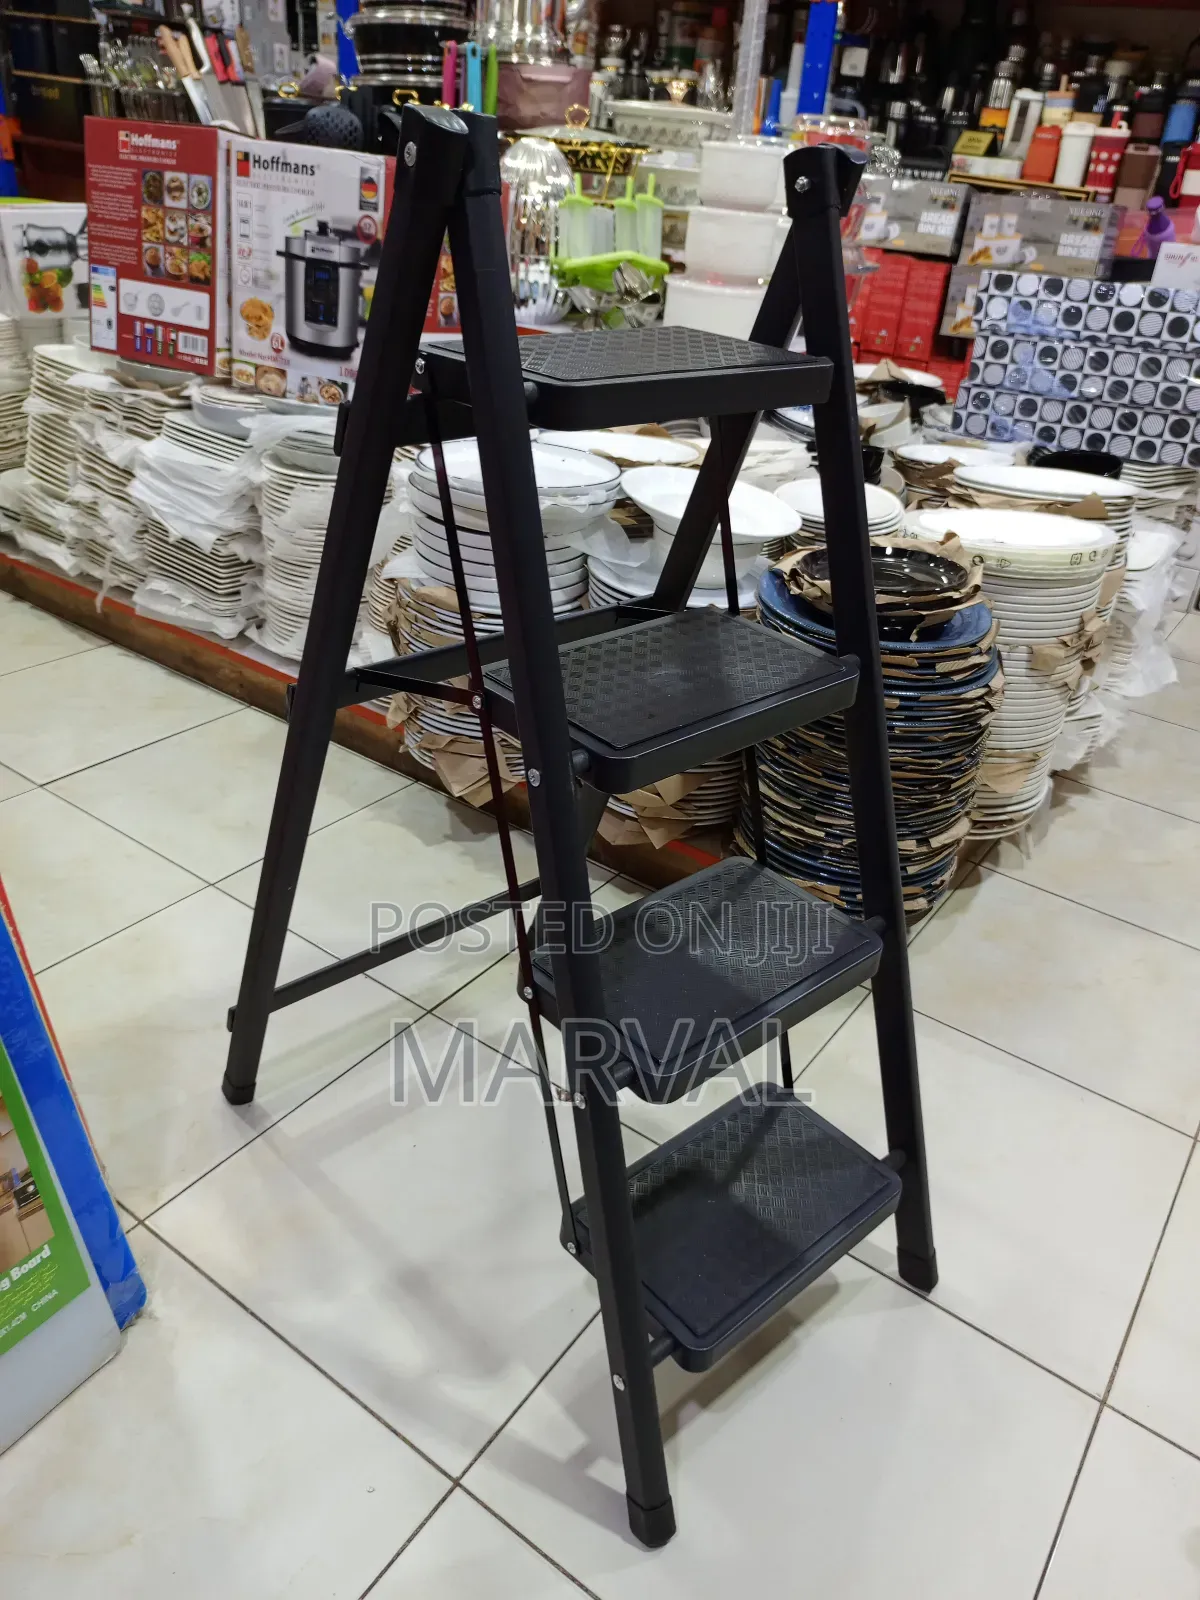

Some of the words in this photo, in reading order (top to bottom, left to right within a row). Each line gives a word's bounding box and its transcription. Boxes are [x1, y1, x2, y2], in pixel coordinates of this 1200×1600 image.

[131, 132, 177, 150] Hoffmans
[252, 154, 316, 177] Hoffmans
[10, 1243, 52, 1282] Board
[31, 1288, 59, 1312] CHINA
